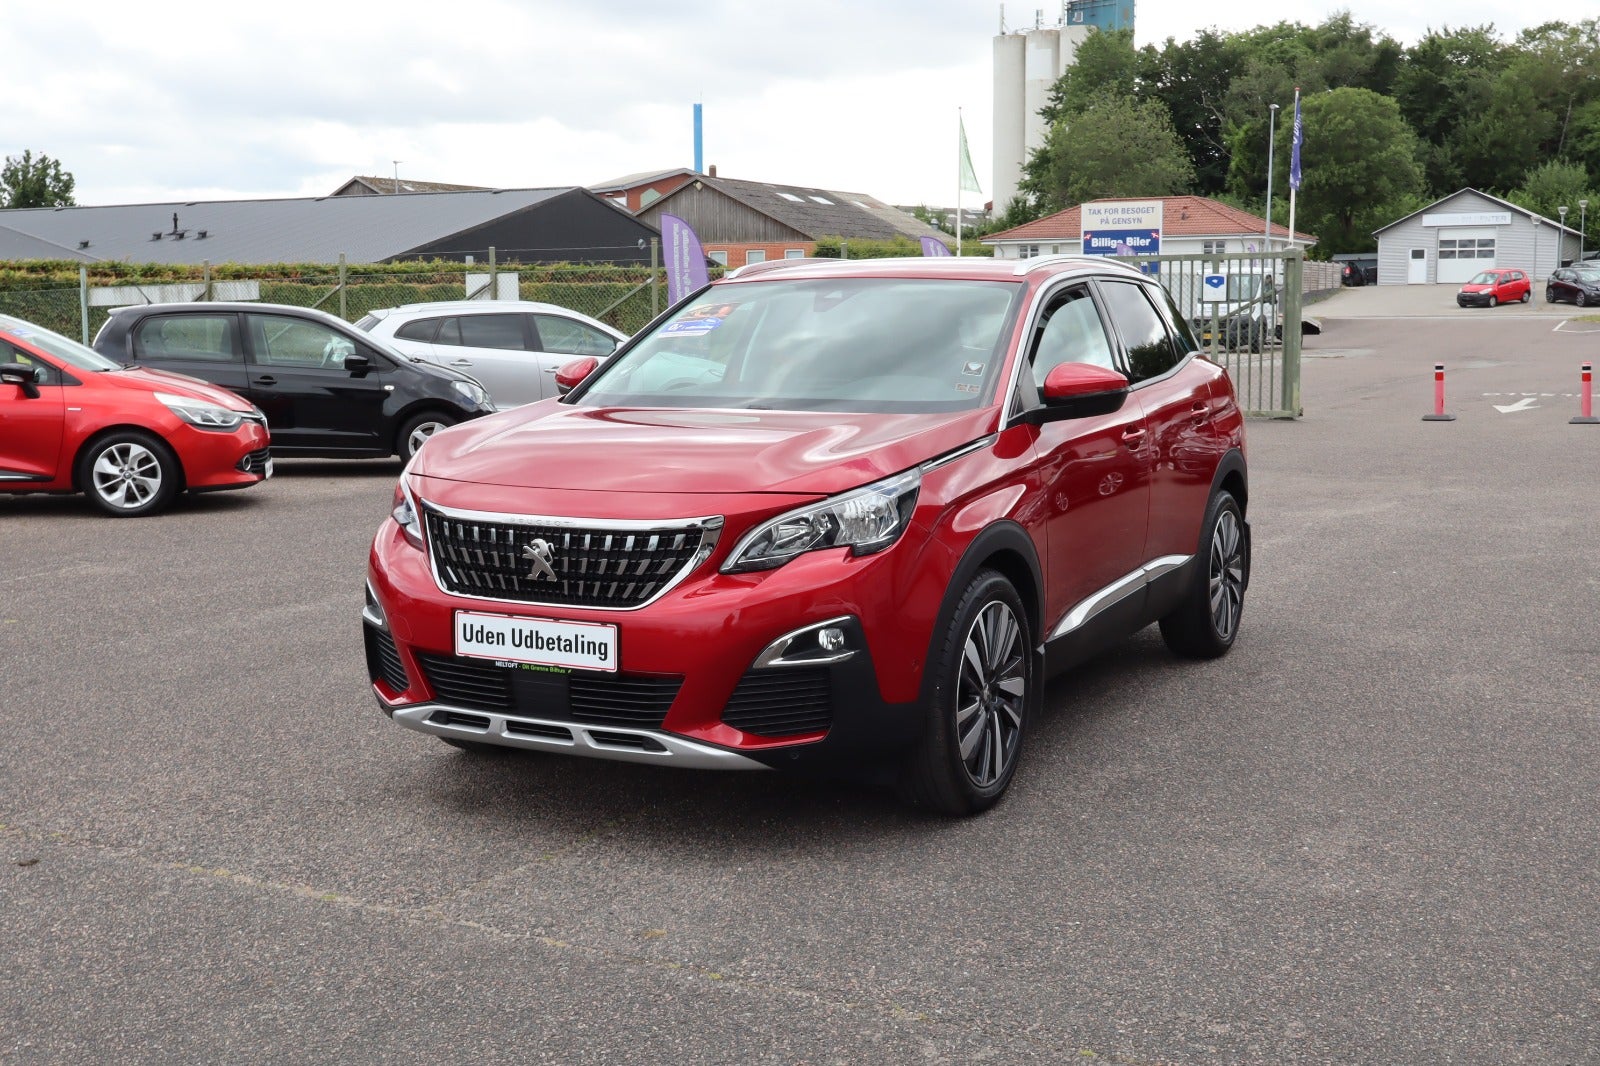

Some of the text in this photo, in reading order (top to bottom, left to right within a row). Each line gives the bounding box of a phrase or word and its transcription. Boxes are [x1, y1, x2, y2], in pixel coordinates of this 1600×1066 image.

[1121, 206, 1156, 214] BESØGET
[1100, 217, 1142, 225] PÅ GENSYN
[1126, 237, 1151, 246] Biler
[463, 623, 608, 662] Uden Udbetaling
[495, 660, 518, 669] NELTOFT
